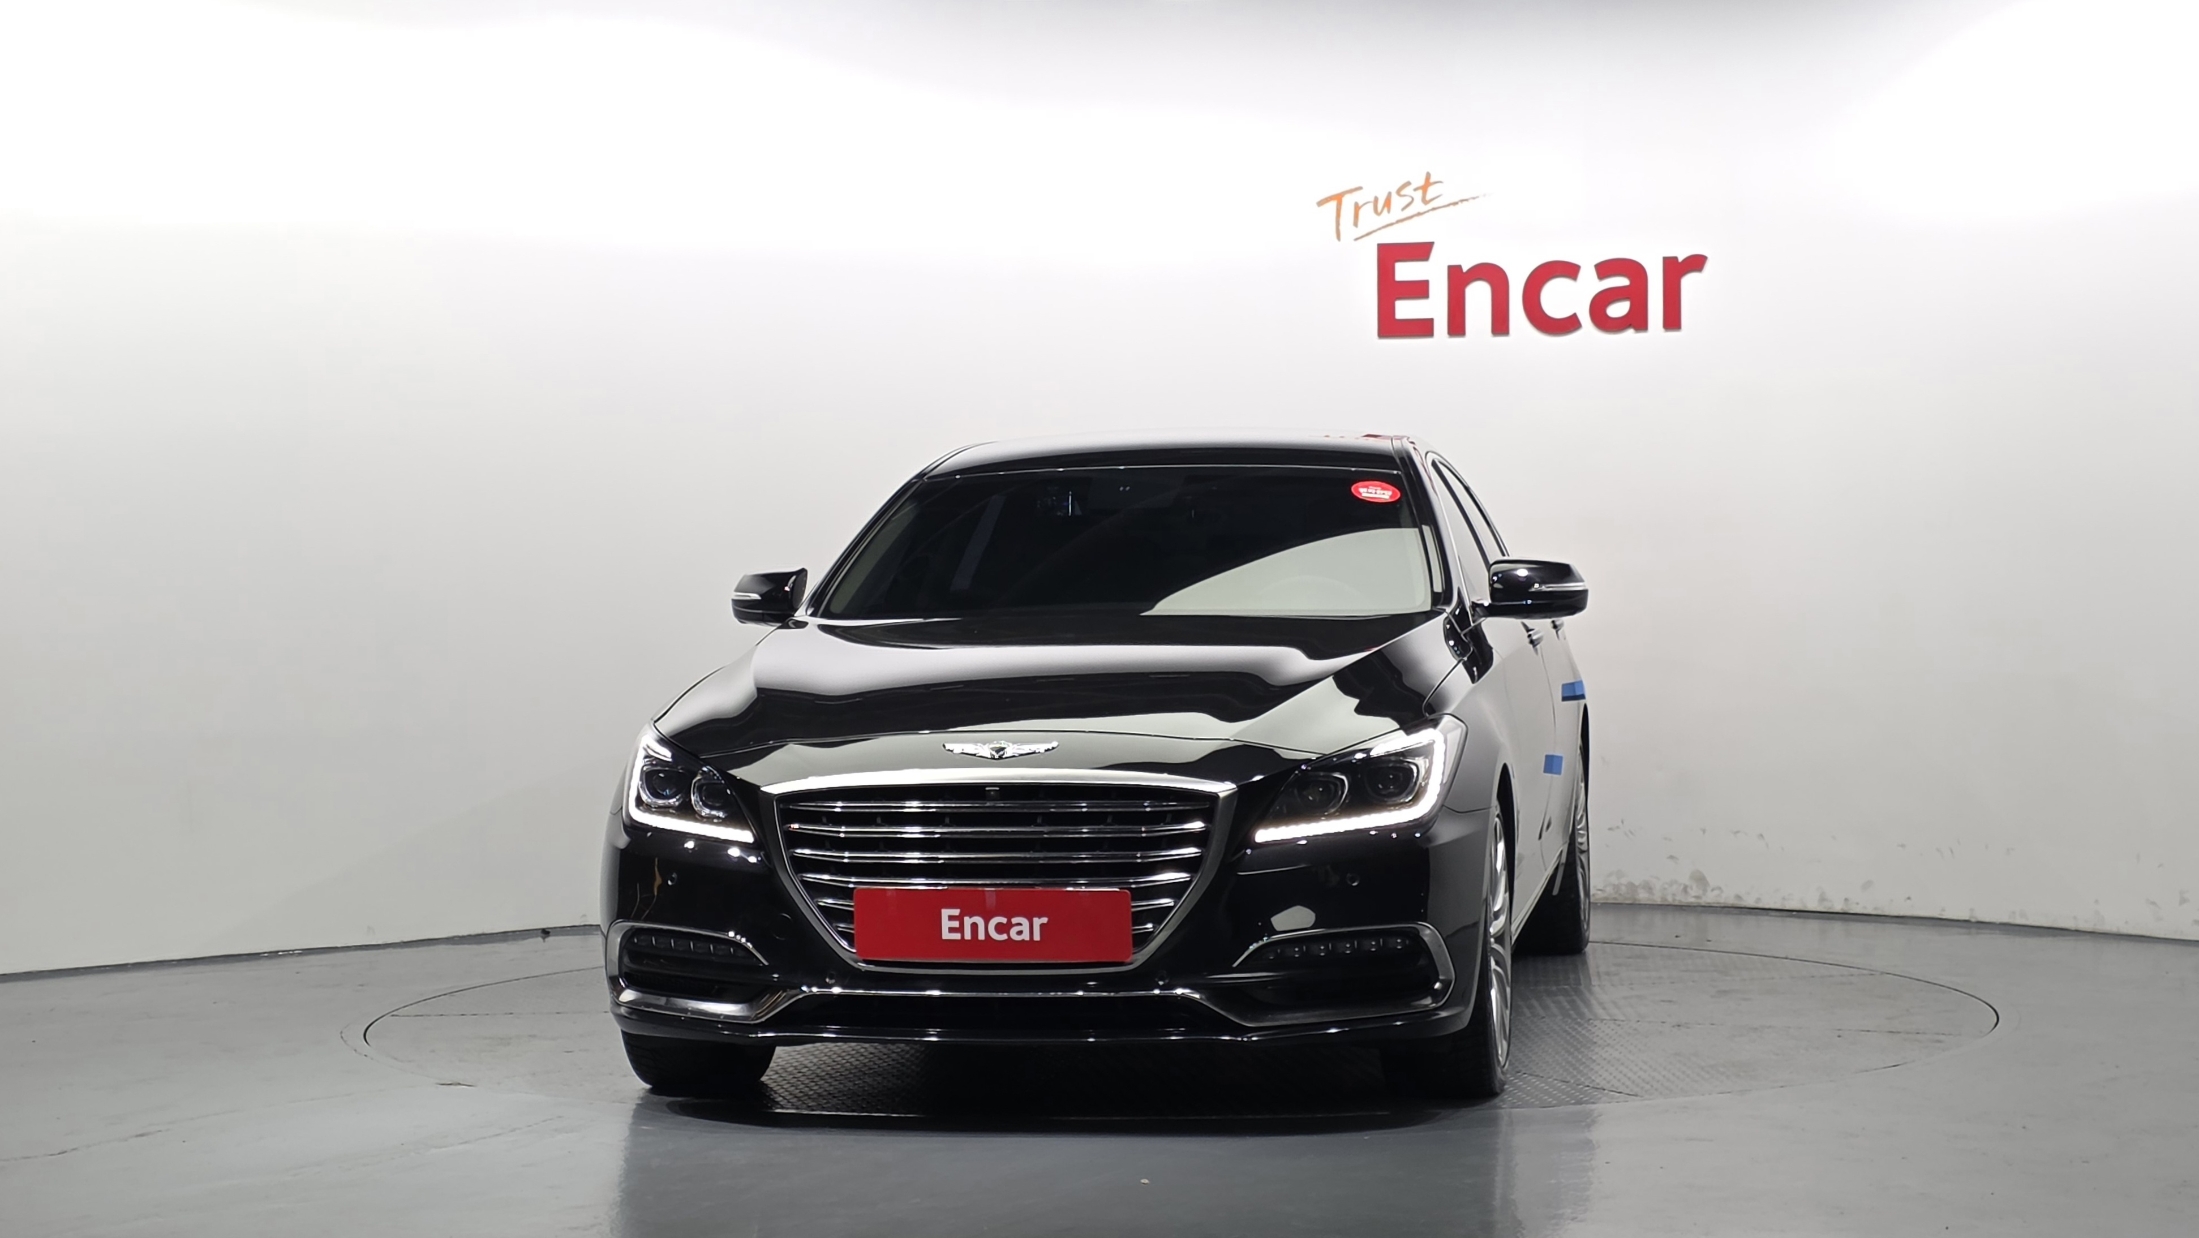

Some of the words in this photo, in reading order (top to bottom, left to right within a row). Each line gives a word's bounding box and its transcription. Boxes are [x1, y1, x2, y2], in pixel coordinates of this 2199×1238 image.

[1316, 171, 1444, 241] Trust
[1376, 241, 1709, 338] Encar
[940, 907, 1049, 941] Encar
